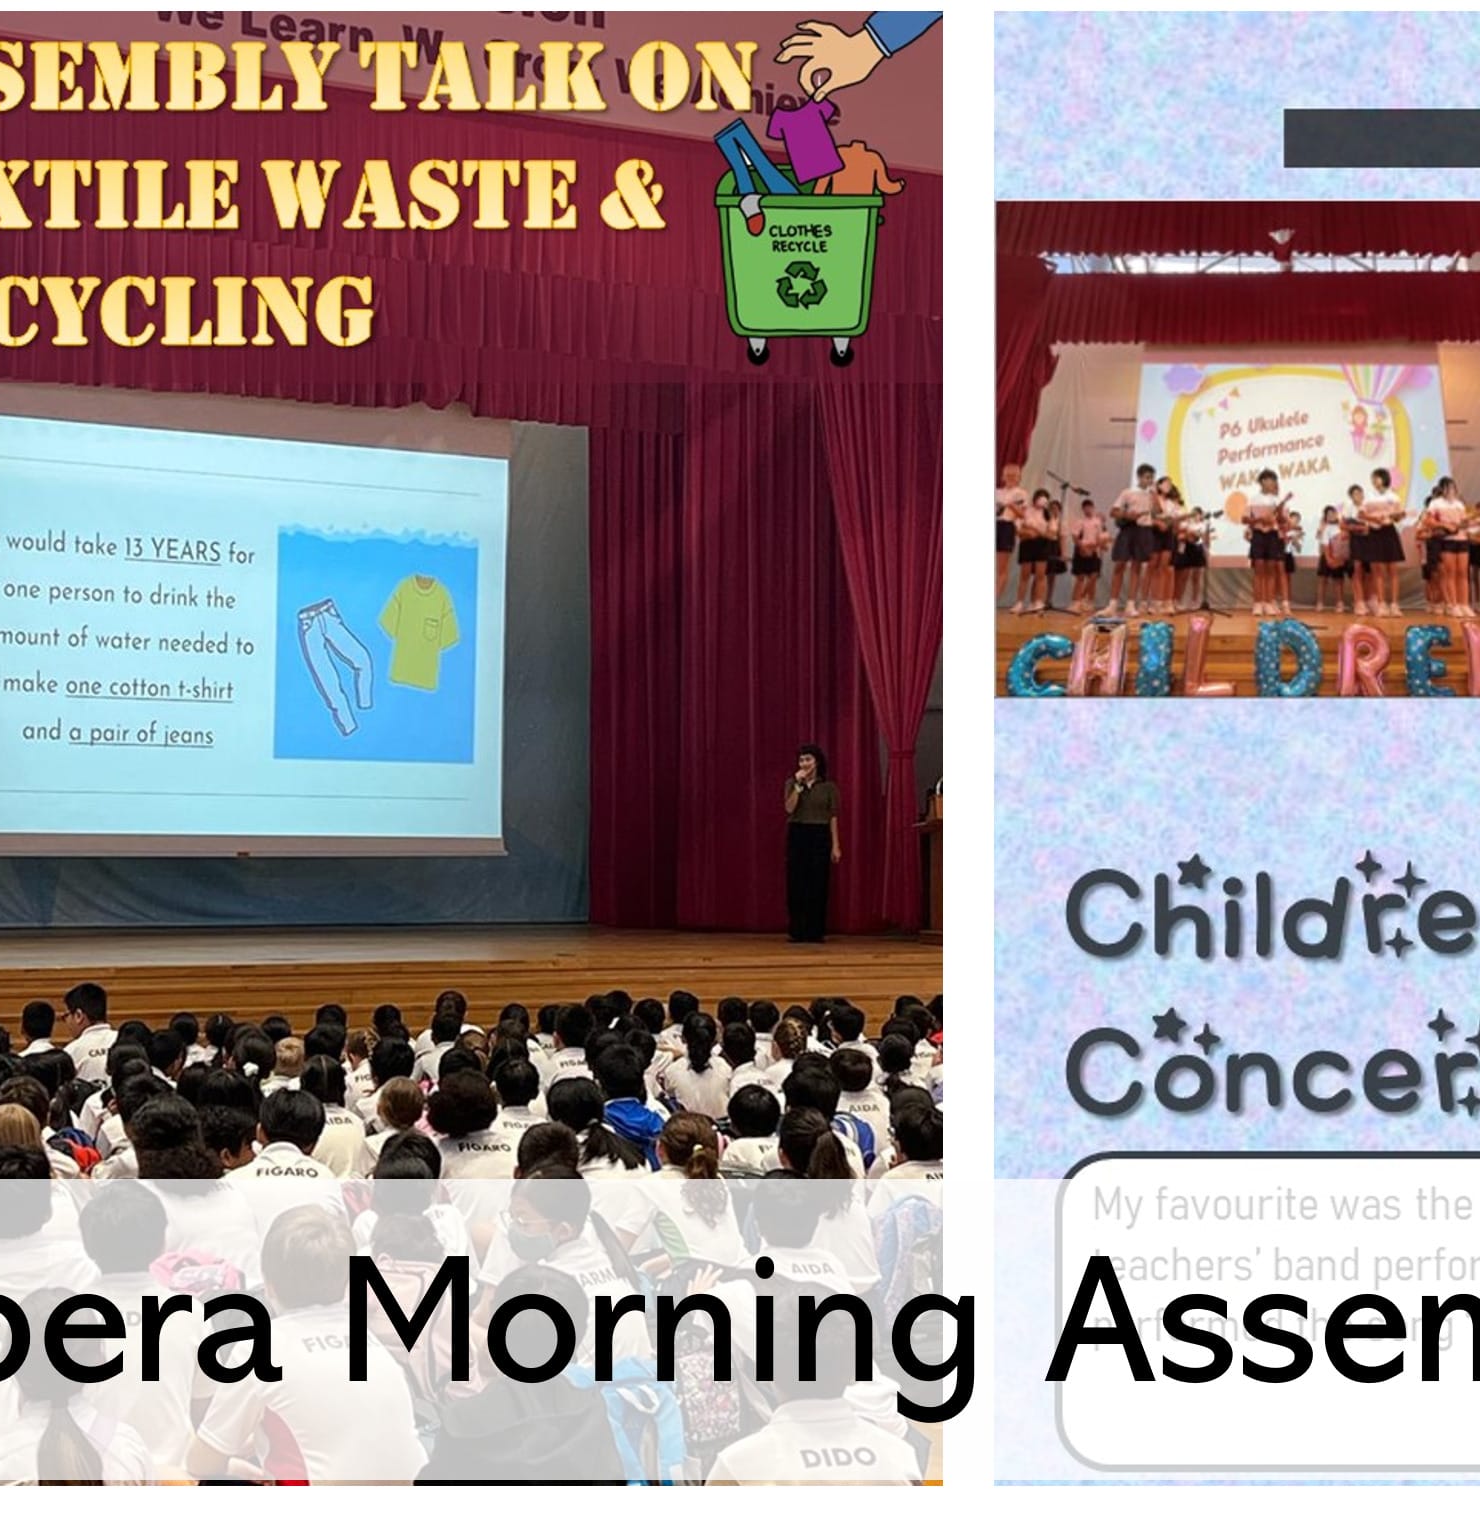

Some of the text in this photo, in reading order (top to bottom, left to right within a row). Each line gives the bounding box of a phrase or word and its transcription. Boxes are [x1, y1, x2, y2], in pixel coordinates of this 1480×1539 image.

[1220, 411, 1309, 439] P6 Ukulele
[1217, 434, 1325, 466] Performance
[1219, 455, 1331, 491] WAK WAKA
[6, 530, 66, 553] would
[74, 532, 118, 556] take
[124, 536, 144, 558] 13
[151, 537, 221, 563] YEARS
[228, 541, 256, 564] for
[3, 583, 236, 609] one person to drink the
[67, 625, 88, 648] of
[96, 632, 151, 651] water
[158, 631, 228, 654] needed
[236, 638, 255, 655] to
[3, 669, 234, 699] make one cotton t-shirt
[22, 717, 214, 747] and a pair of jeans
[848, 1103, 880, 1113] AIDA
[458, 1142, 511, 1153] FIGARO
[256, 1166, 319, 1179] FIGARO
[791, 1262, 835, 1276] AIDA
[800, 1446, 877, 1469] DIDO
